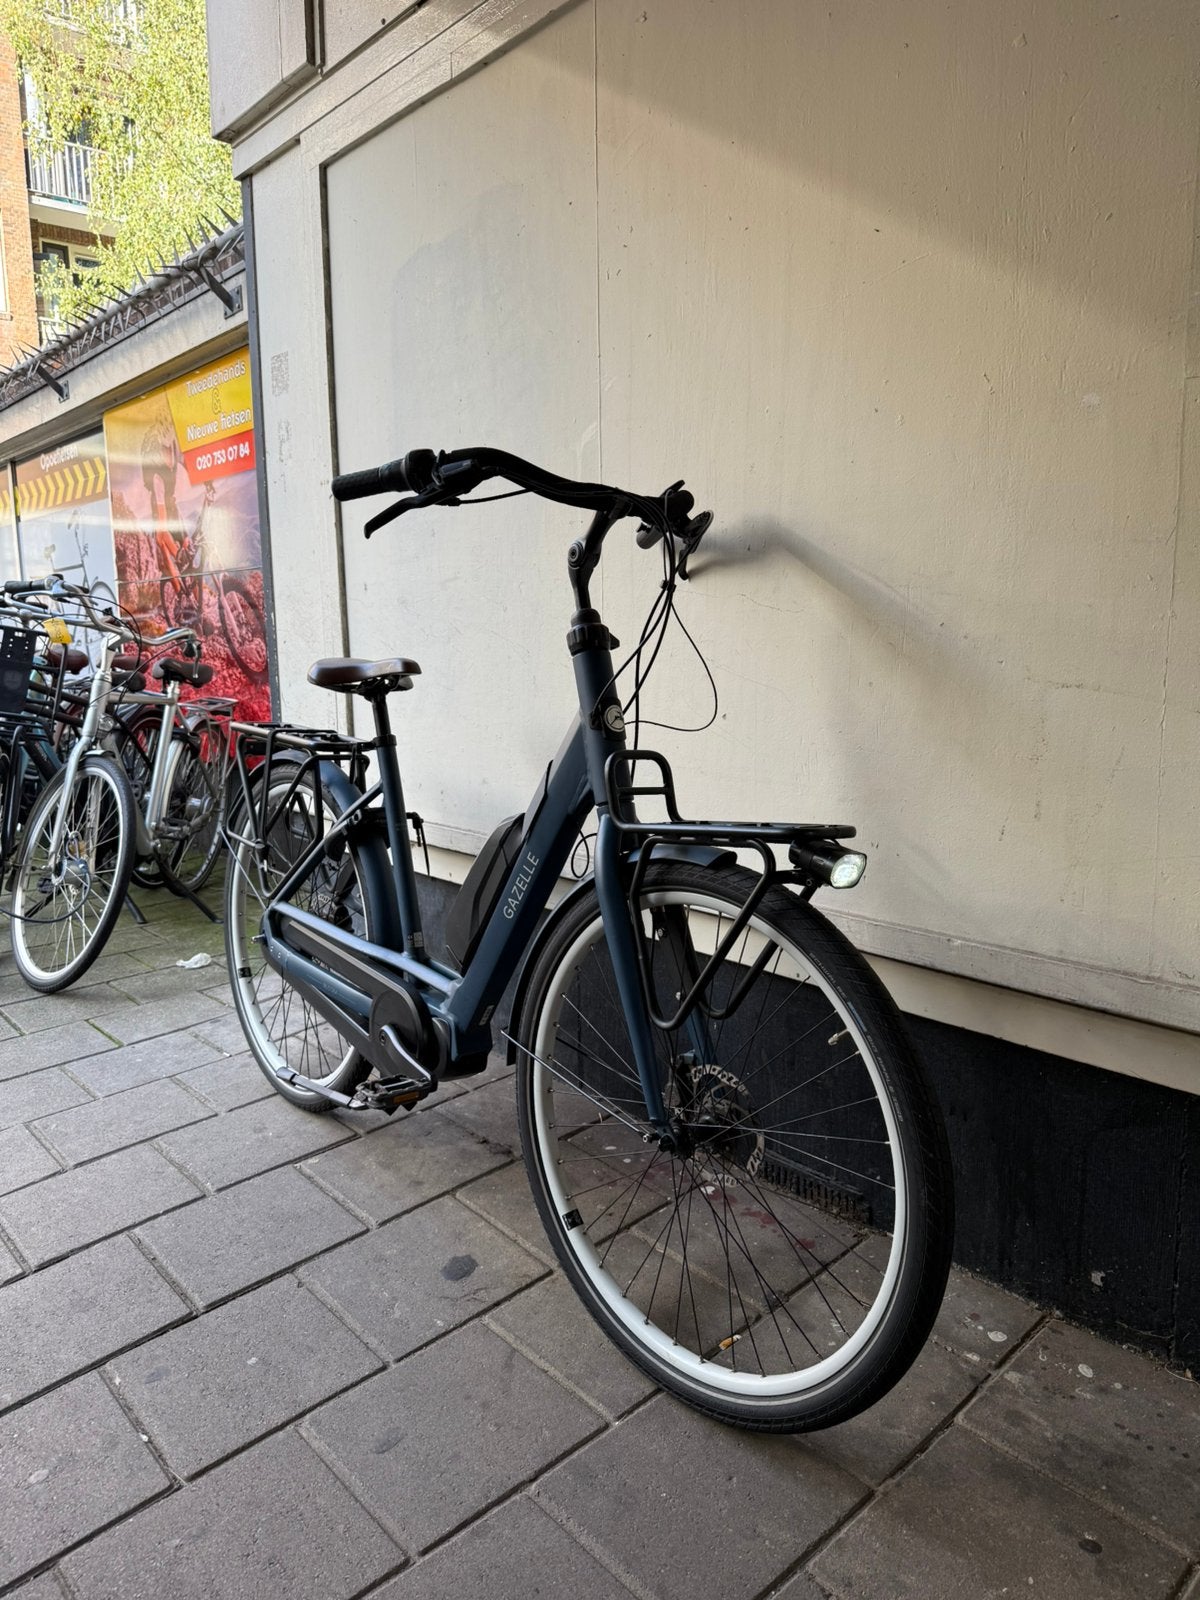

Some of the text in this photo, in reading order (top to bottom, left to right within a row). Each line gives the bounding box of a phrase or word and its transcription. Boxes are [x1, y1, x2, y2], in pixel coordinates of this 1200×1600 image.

[186, 359, 246, 397] Tweedehands
[212, 387, 222, 415] &
[187, 409, 251, 442] Nieuwe fietsen
[196, 442, 250, 471] 020 753 07 84
[503, 851, 540, 919] GAZELLE
